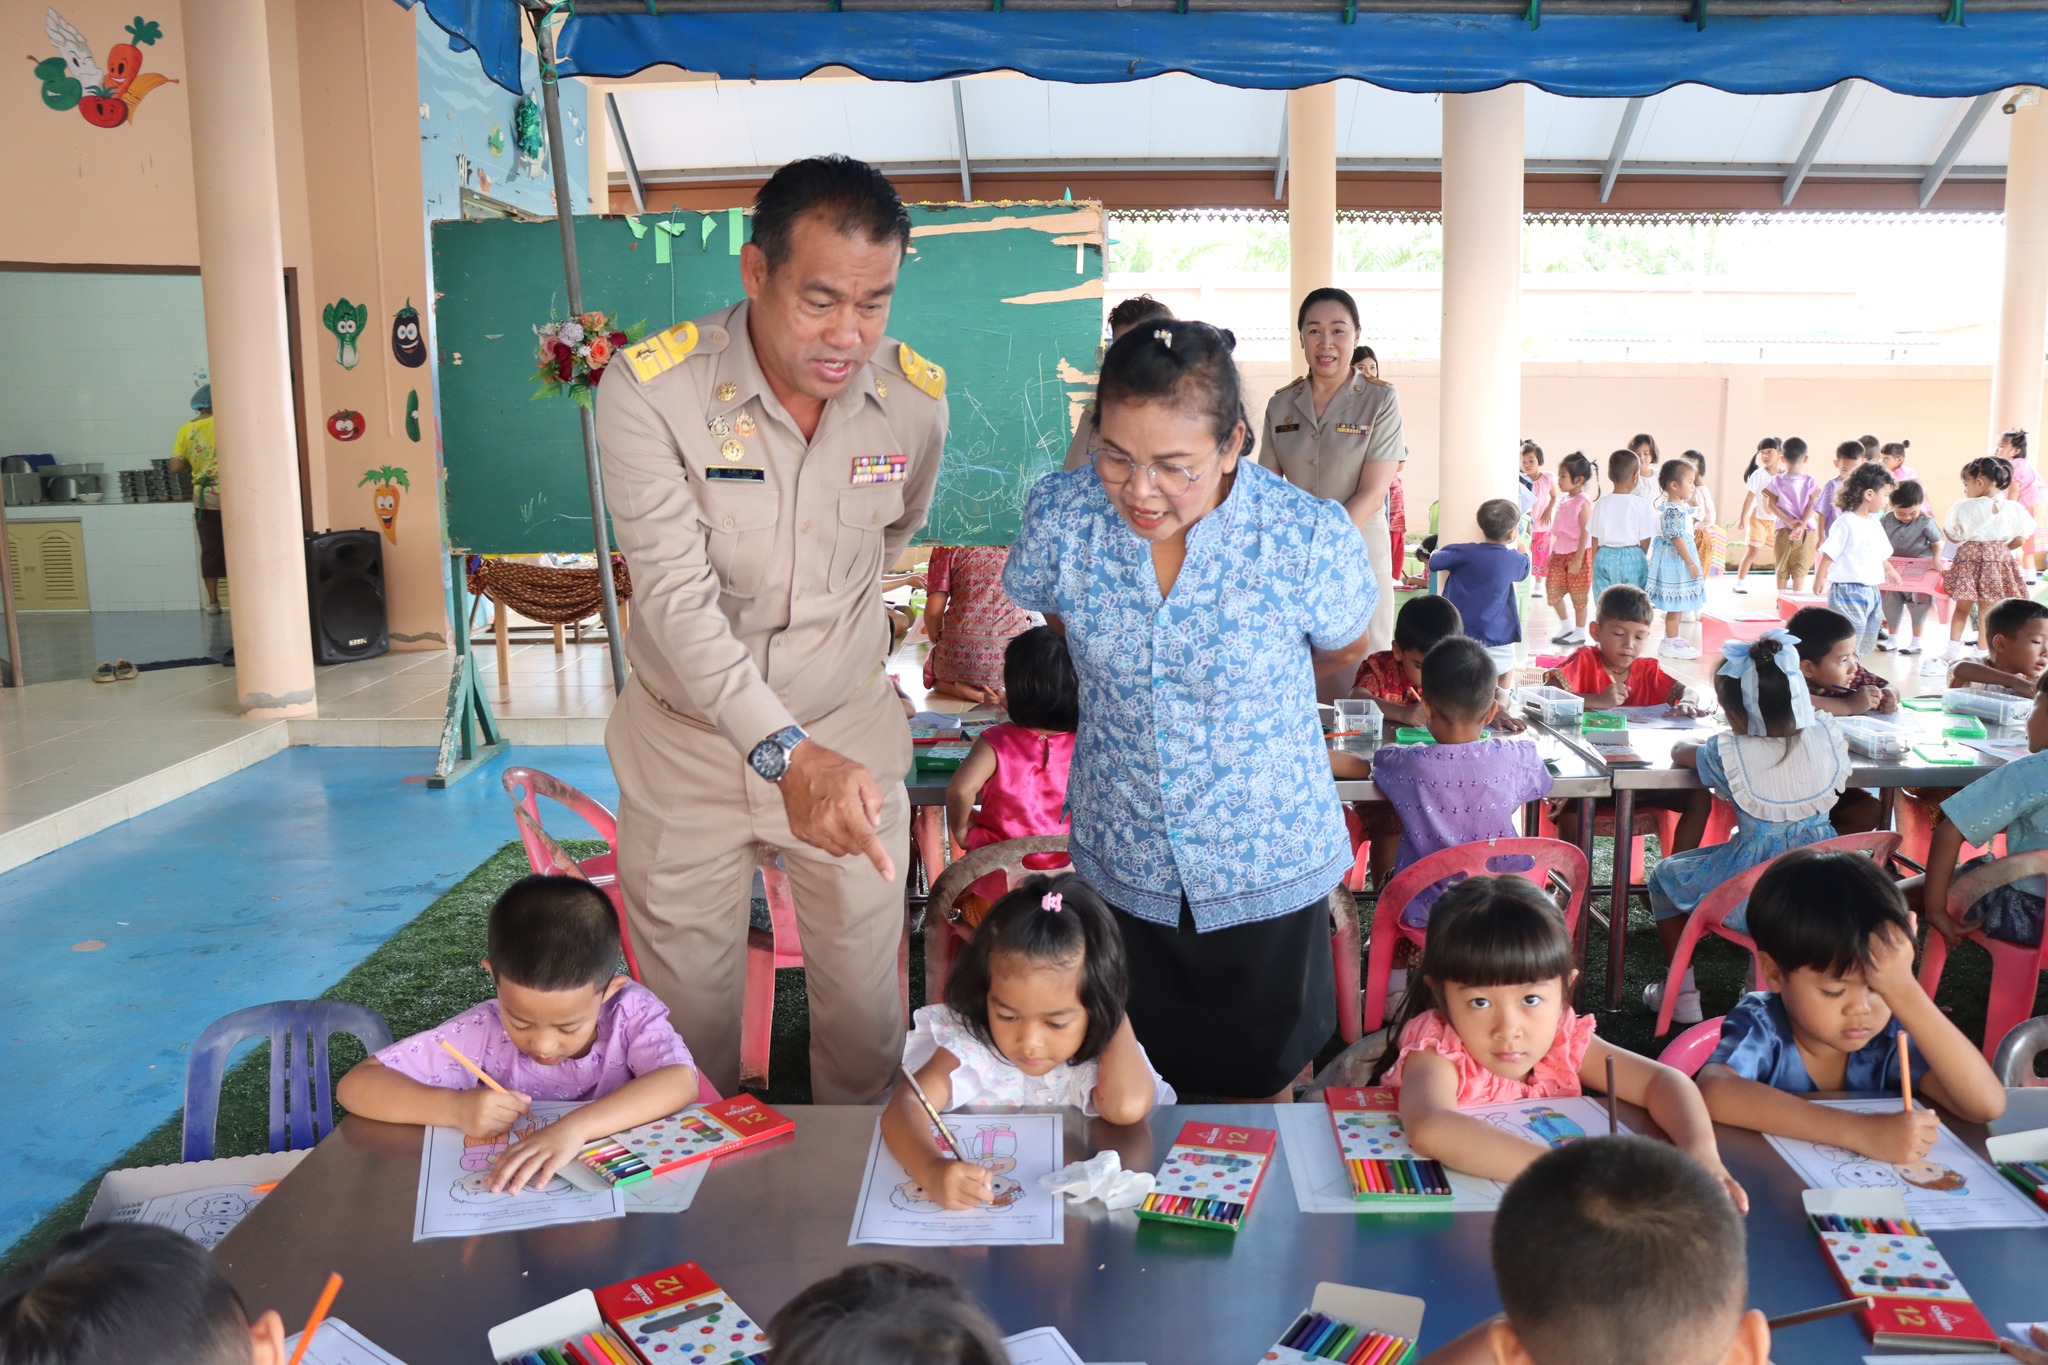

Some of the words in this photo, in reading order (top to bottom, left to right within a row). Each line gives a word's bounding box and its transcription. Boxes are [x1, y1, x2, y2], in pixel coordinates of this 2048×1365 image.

[1374, 1090, 1395, 1106] 12
[724, 1104, 757, 1117] COLLEEN
[738, 1112, 768, 1125] 12
[1226, 1131, 1249, 1145] 12
[654, 1275, 684, 1296] 12
[631, 1283, 653, 1305] COLLEEN
[1893, 1305, 1927, 1327] 12
